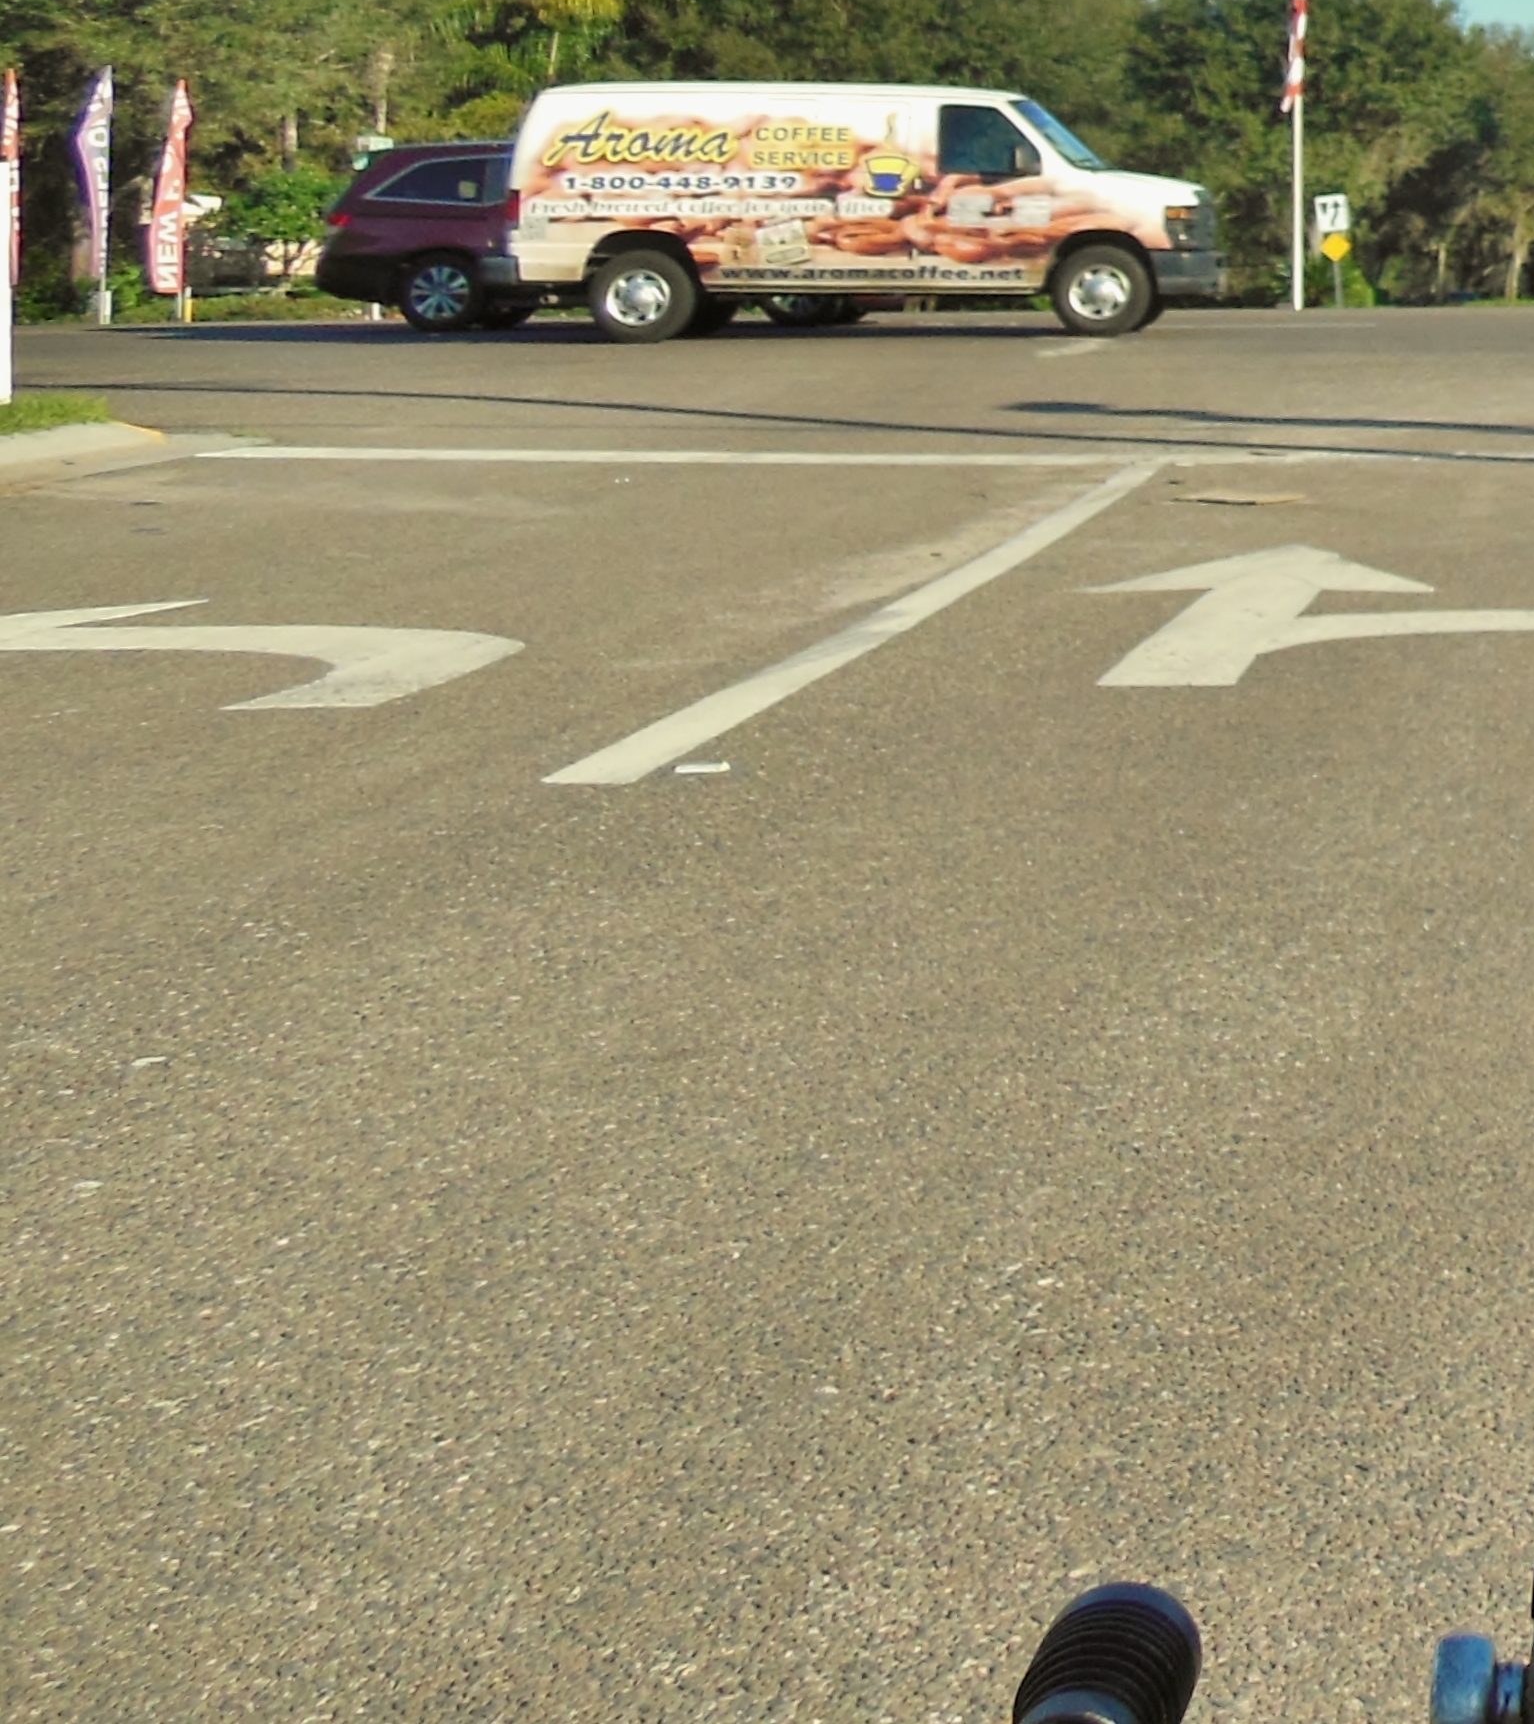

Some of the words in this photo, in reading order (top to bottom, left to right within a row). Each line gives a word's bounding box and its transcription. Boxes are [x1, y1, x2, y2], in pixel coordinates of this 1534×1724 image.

[549, 110, 730, 160] Aroma
[755, 127, 850, 142] COFFEE
[752, 151, 850, 166] SERVICE
[565, 176, 797, 190] 1-800-448-9139
[720, 265, 1024, 281] www.aromacoffee.net
